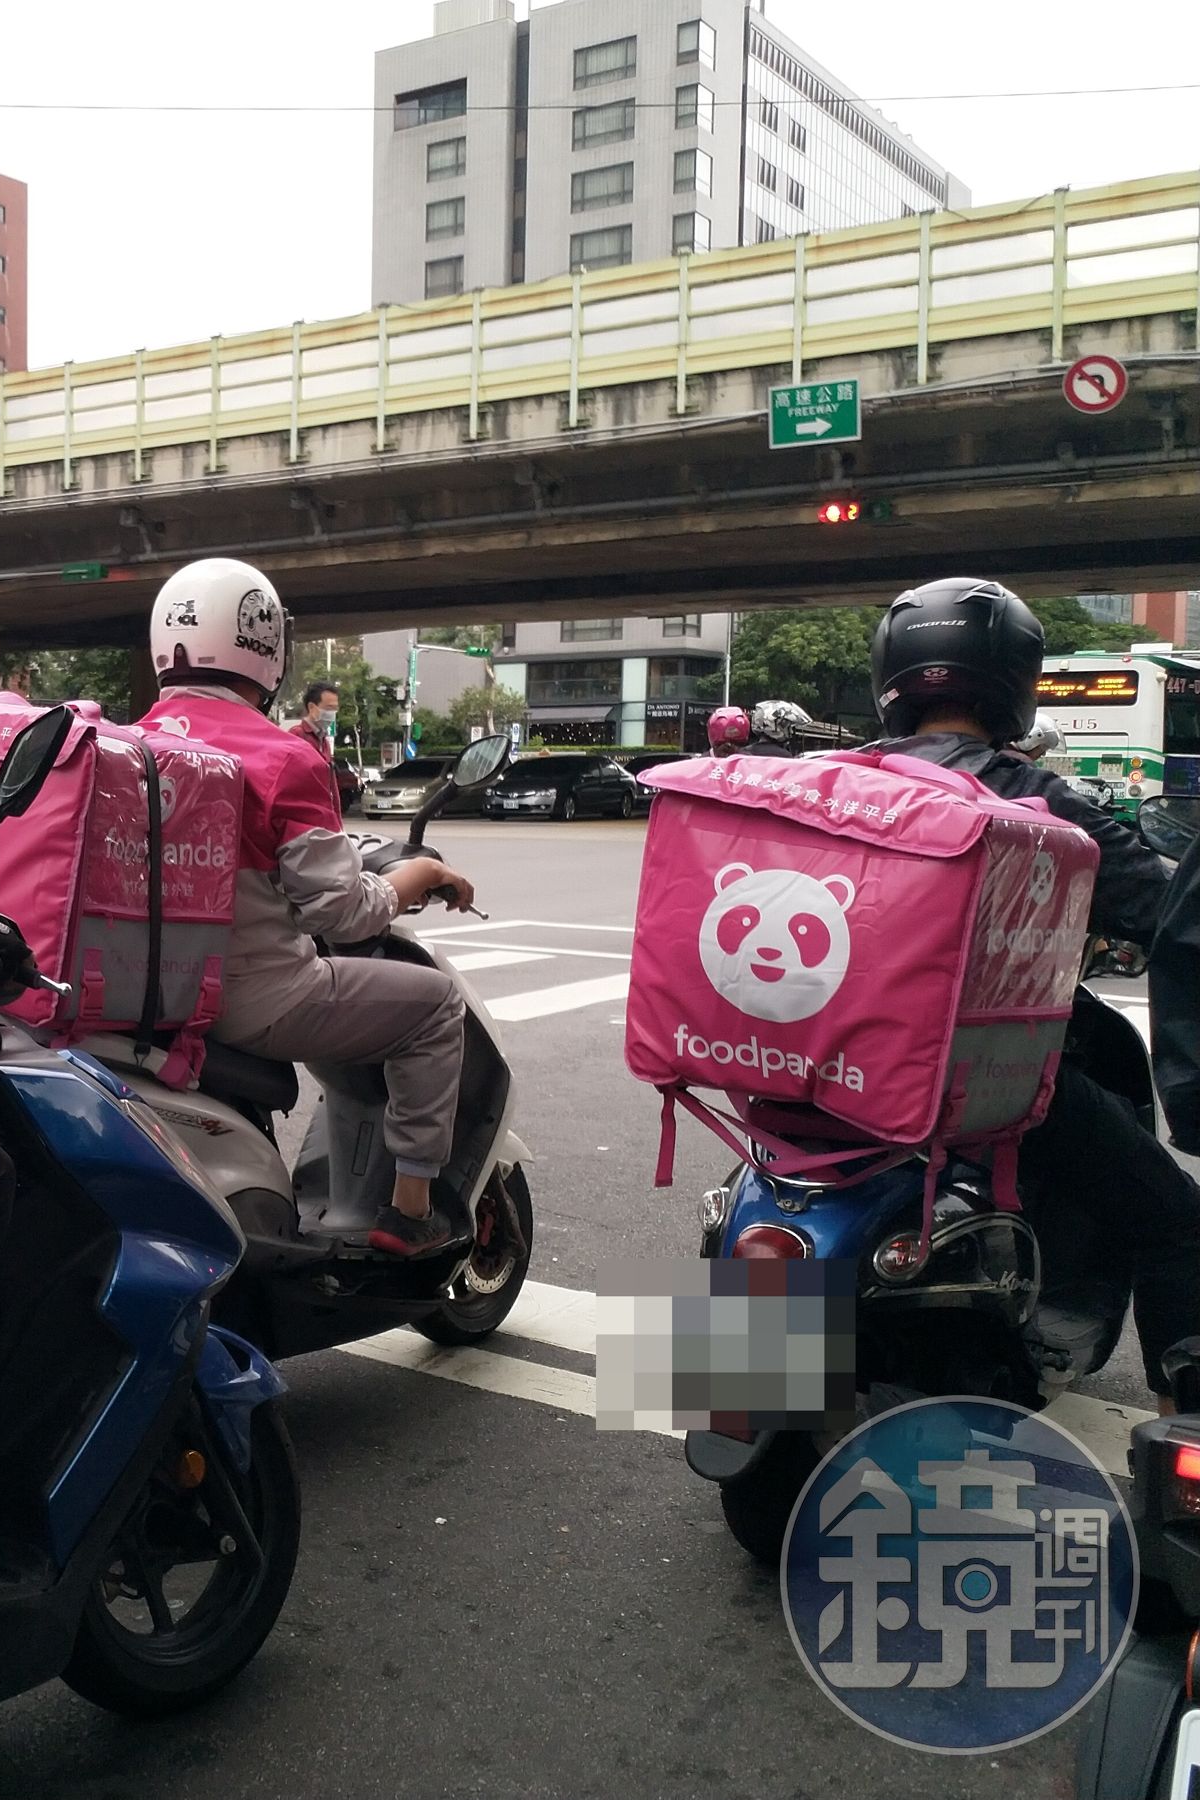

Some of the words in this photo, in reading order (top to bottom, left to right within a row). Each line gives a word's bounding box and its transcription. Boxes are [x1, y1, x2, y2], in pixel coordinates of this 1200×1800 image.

[774, 383, 854, 409] 高速公路
[787, 402, 839, 418] FREEWAY
[709, 765, 899, 825] 全台最大美食外送平台
[104, 826, 227, 868] foodanda
[673, 1023, 865, 1094] foodpanda
